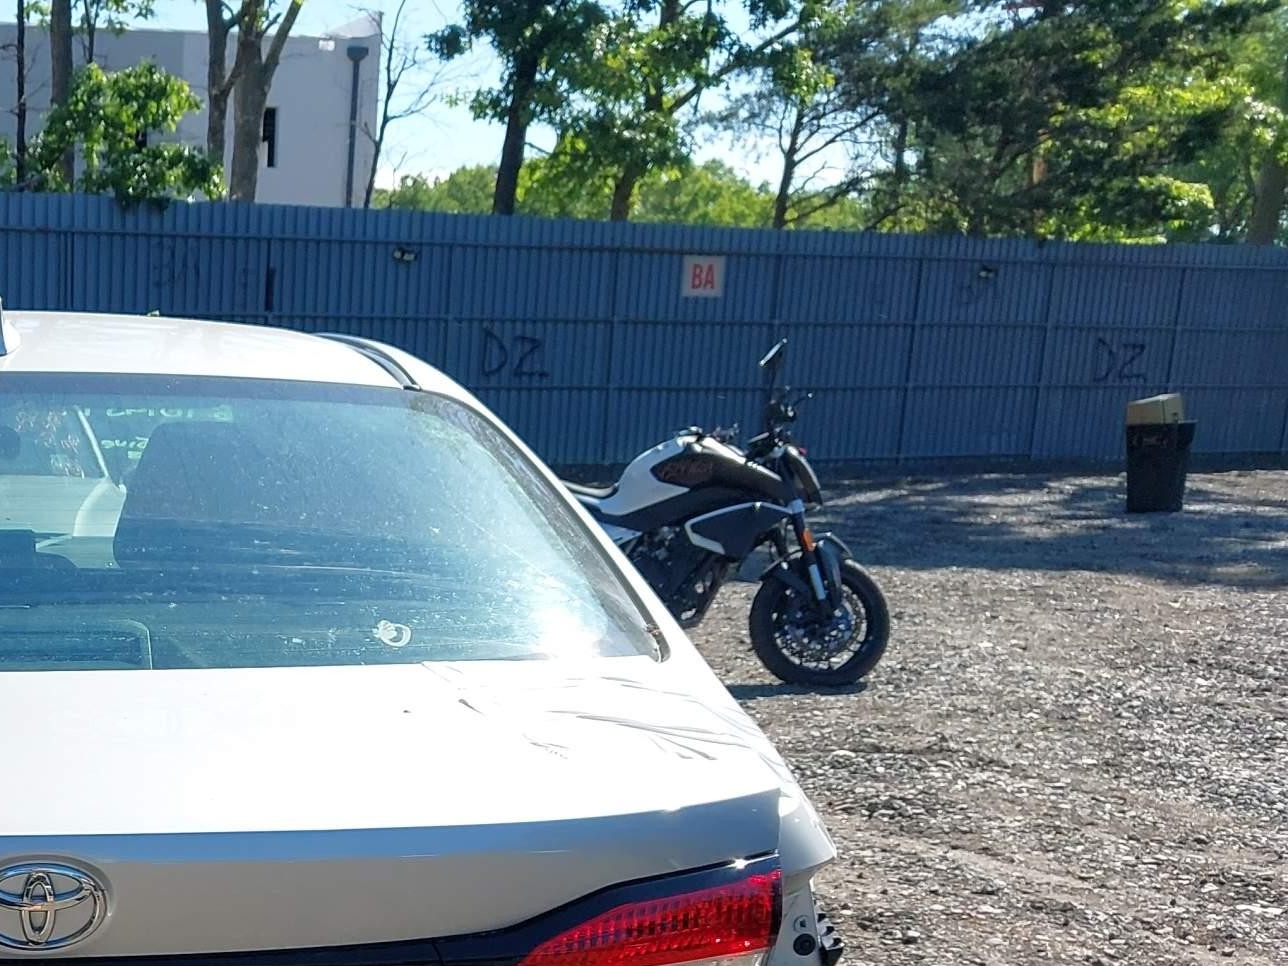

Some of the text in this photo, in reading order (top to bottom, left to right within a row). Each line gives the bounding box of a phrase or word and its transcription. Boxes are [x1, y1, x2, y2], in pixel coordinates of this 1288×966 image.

[690, 263, 716, 290] BA
[479, 324, 550, 378] DZ
[1091, 336, 1148, 383] DZ
